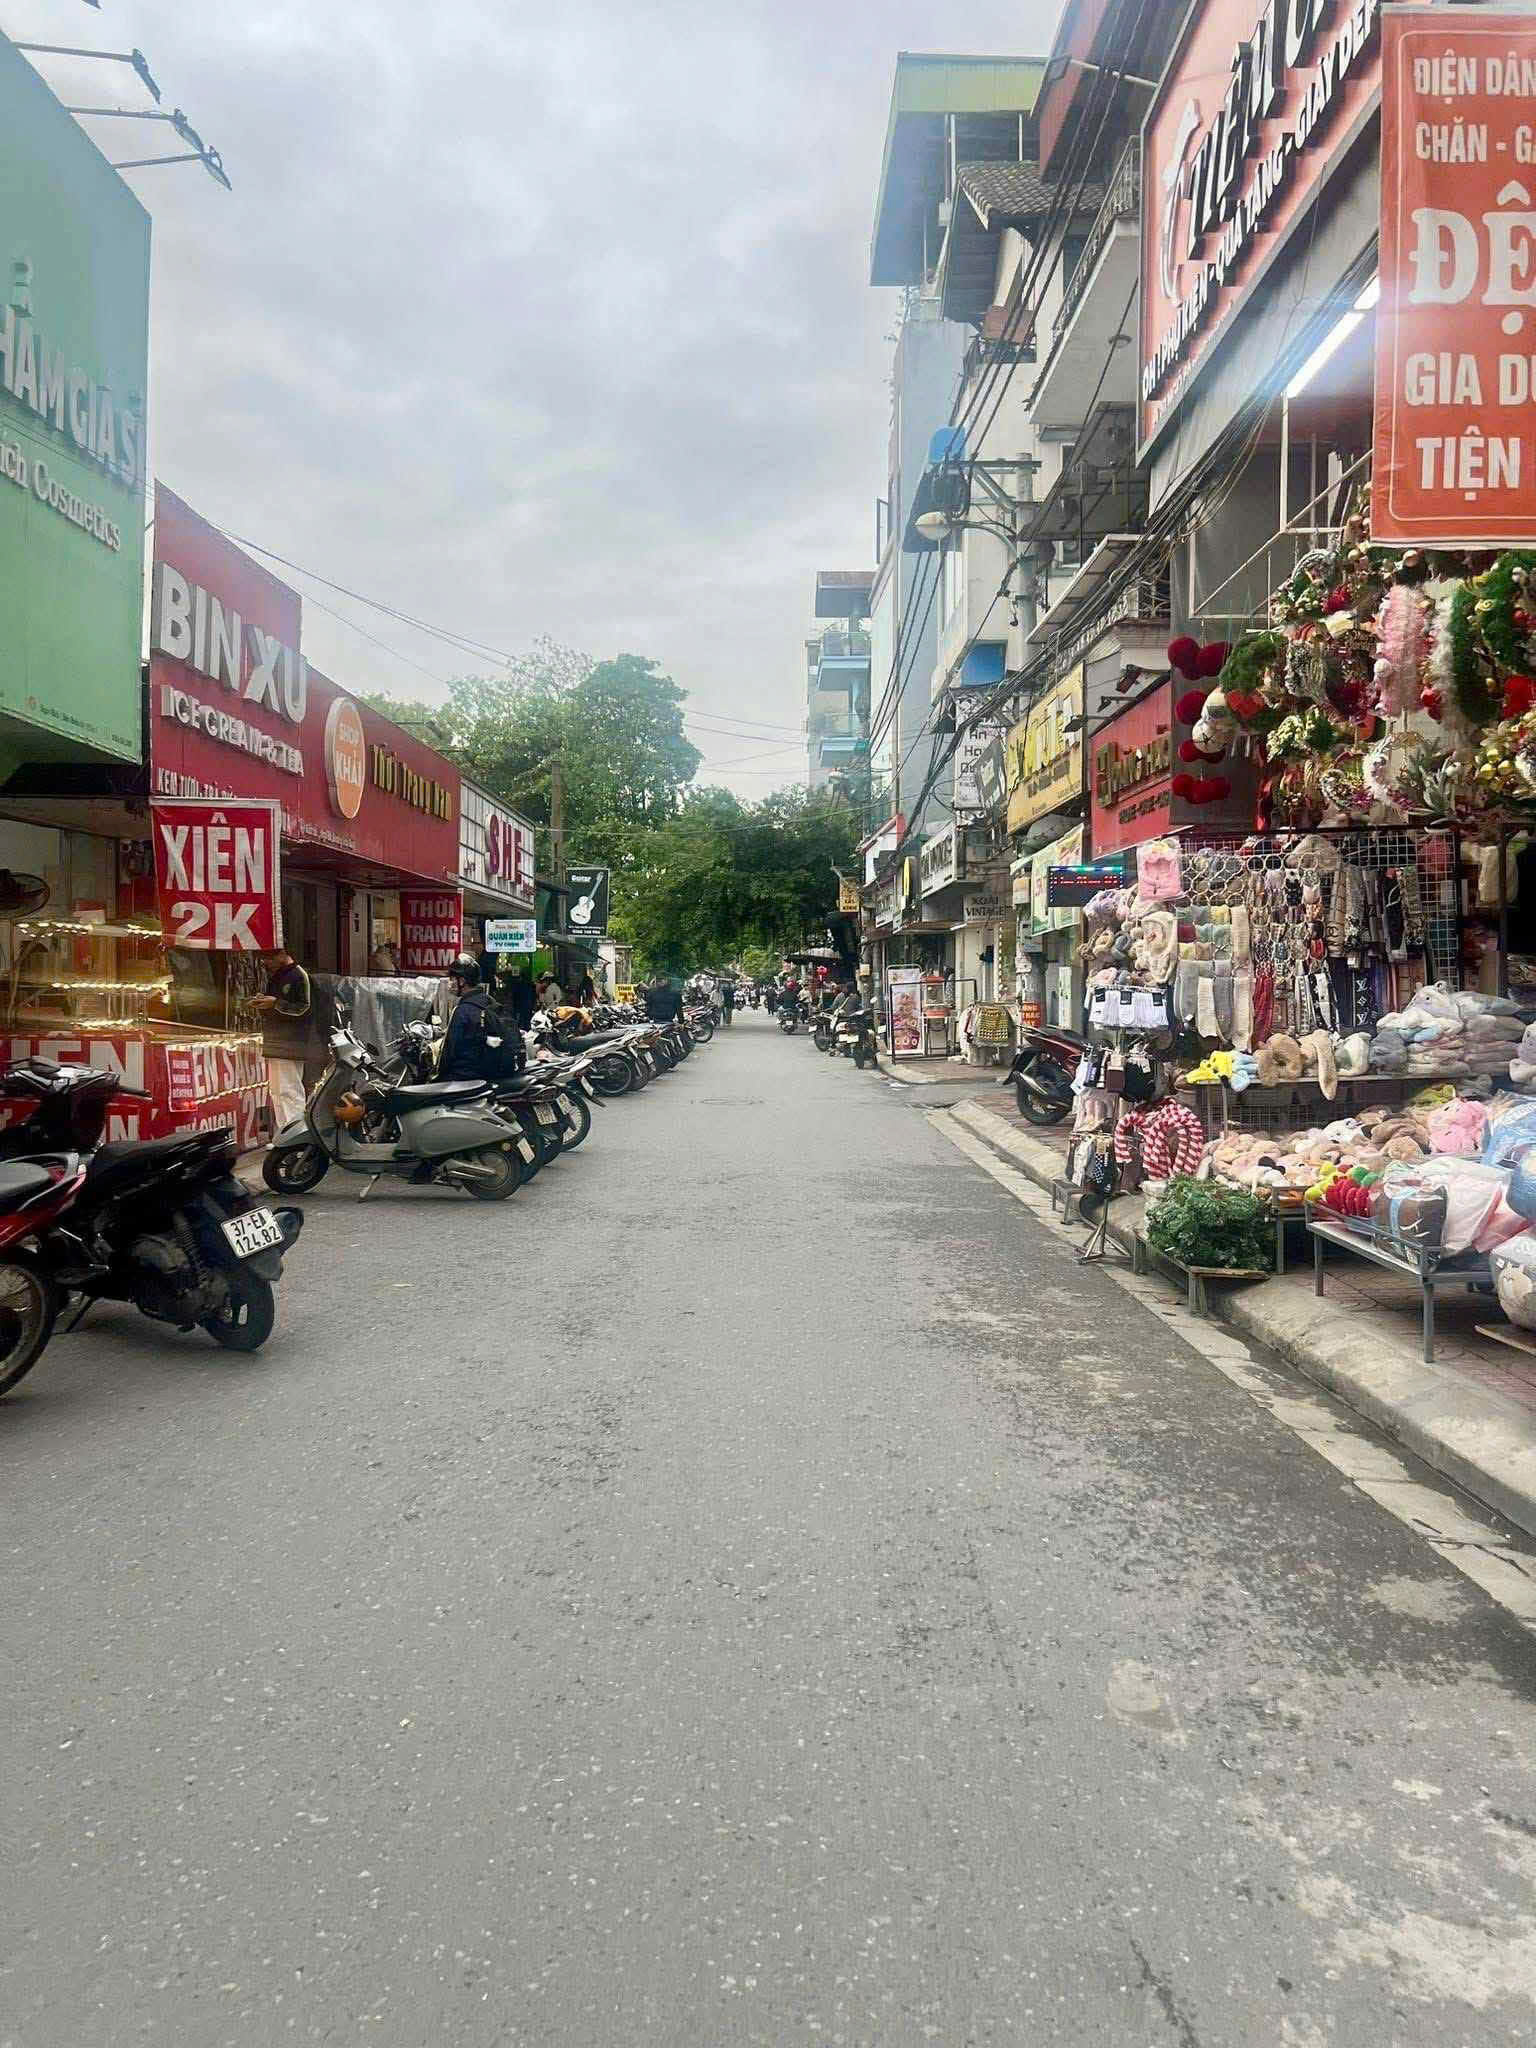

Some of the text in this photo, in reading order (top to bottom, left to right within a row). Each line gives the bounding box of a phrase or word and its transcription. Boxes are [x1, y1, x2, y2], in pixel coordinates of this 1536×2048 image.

[1413, 48, 1478, 105] ĐIỆN
[1415, 115, 1489, 163] CHĂN
[1515, 125, 1536, 164] G
[1406, 352, 1536, 406] GIA D
[1416, 425, 1521, 501] TIỆN
[33, 459, 121, 551] Cosmetics
[160, 811, 266, 894] XIÊN
[486, 814, 522, 886] SHE
[170, 901, 263, 950] 2K
[406, 924, 459, 943] TRANG
[407, 947, 456, 968] NAM
[236, 1225, 281, 1254] 124.82
